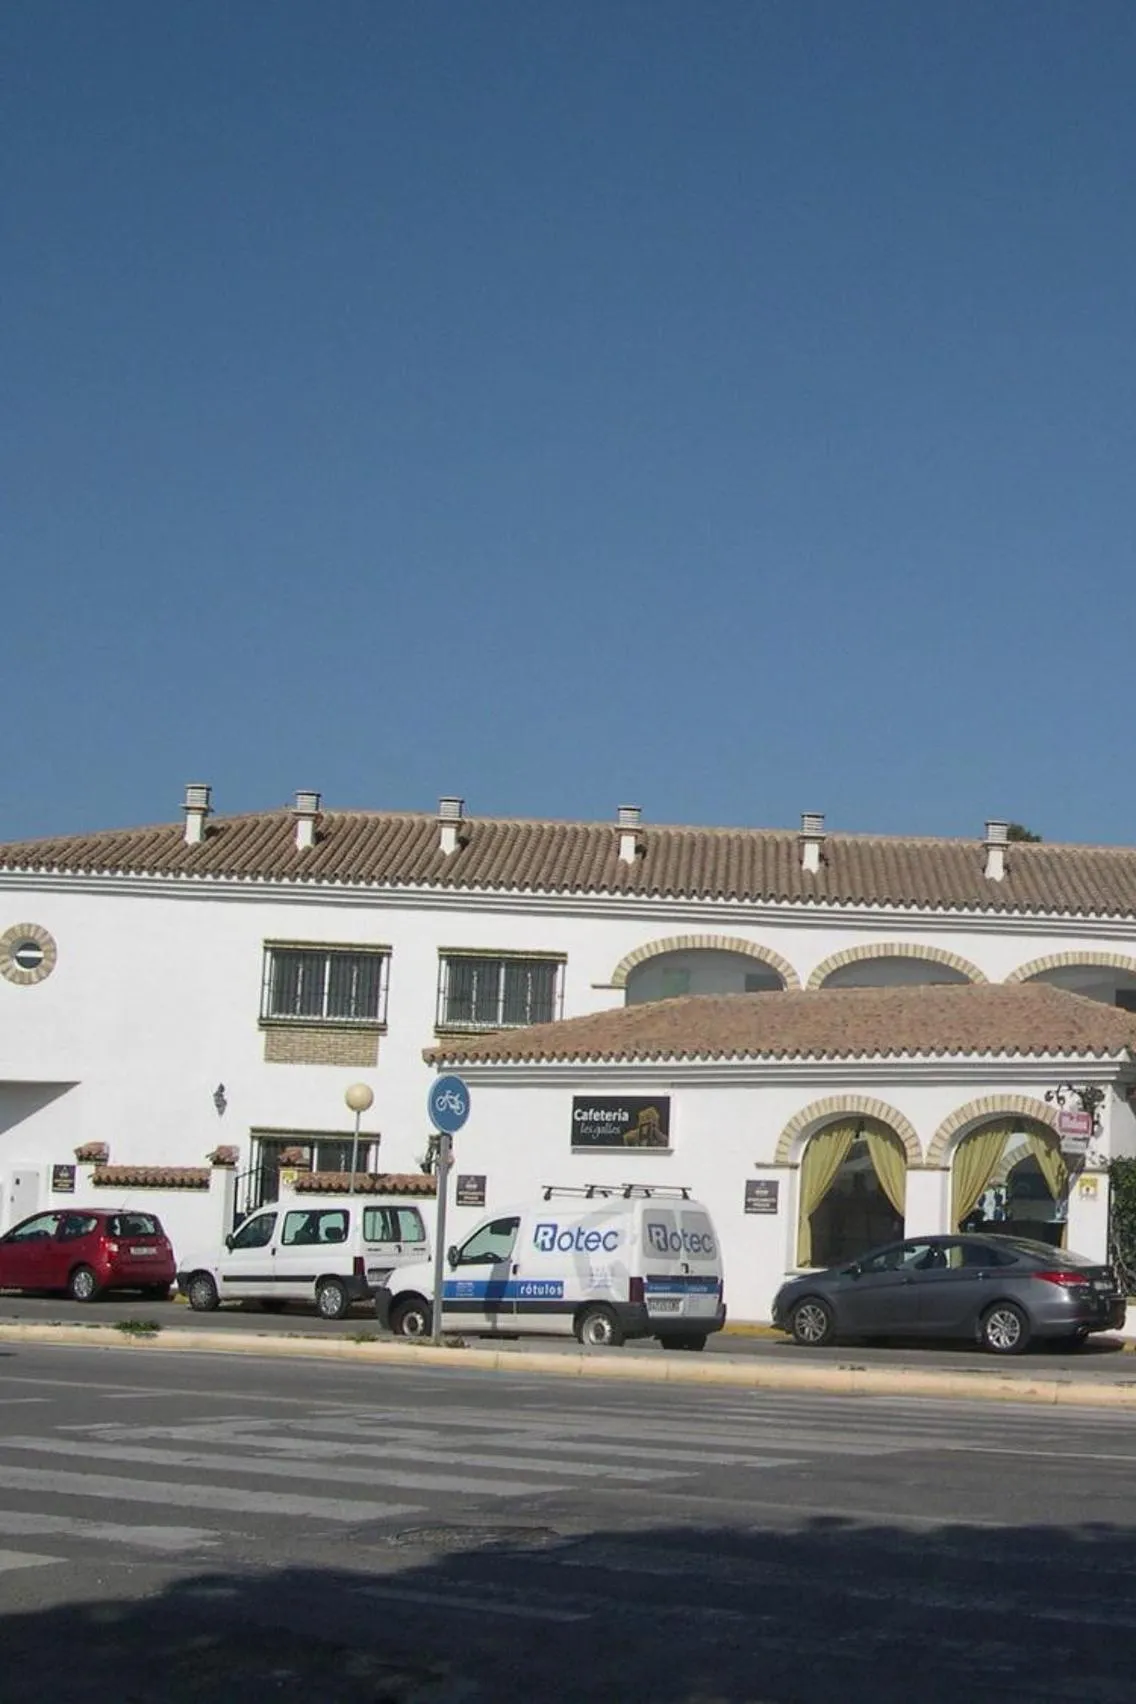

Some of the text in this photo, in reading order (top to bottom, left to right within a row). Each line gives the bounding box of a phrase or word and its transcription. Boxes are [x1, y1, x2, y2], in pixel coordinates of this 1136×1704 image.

[533, 1223, 619, 1252] Rotec
[647, 1223, 714, 1253] Rotec
[519, 1282, 563, 1297] rótulos
